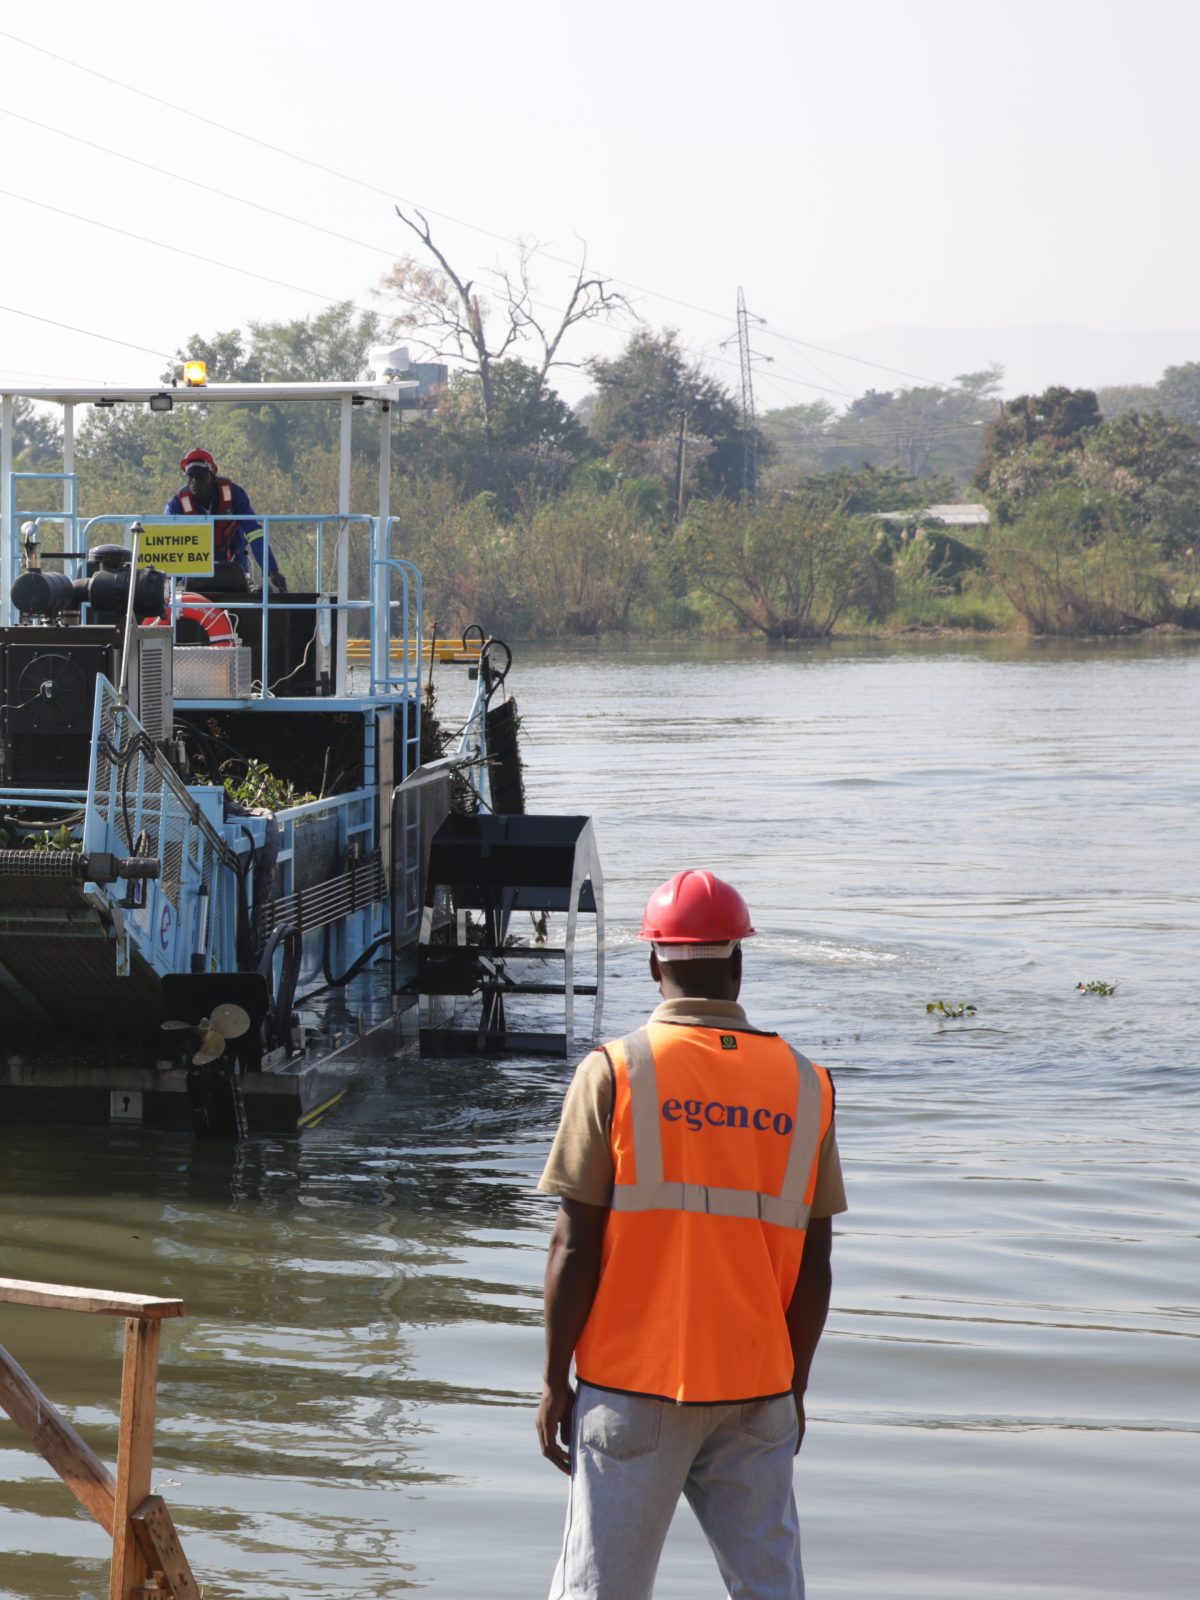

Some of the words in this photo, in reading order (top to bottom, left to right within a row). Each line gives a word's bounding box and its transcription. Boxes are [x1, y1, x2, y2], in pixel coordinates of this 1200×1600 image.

[145, 536, 199, 546] LINTHIPE
[137, 552, 184, 563] MONKEY
[188, 552, 210, 562] BAY
